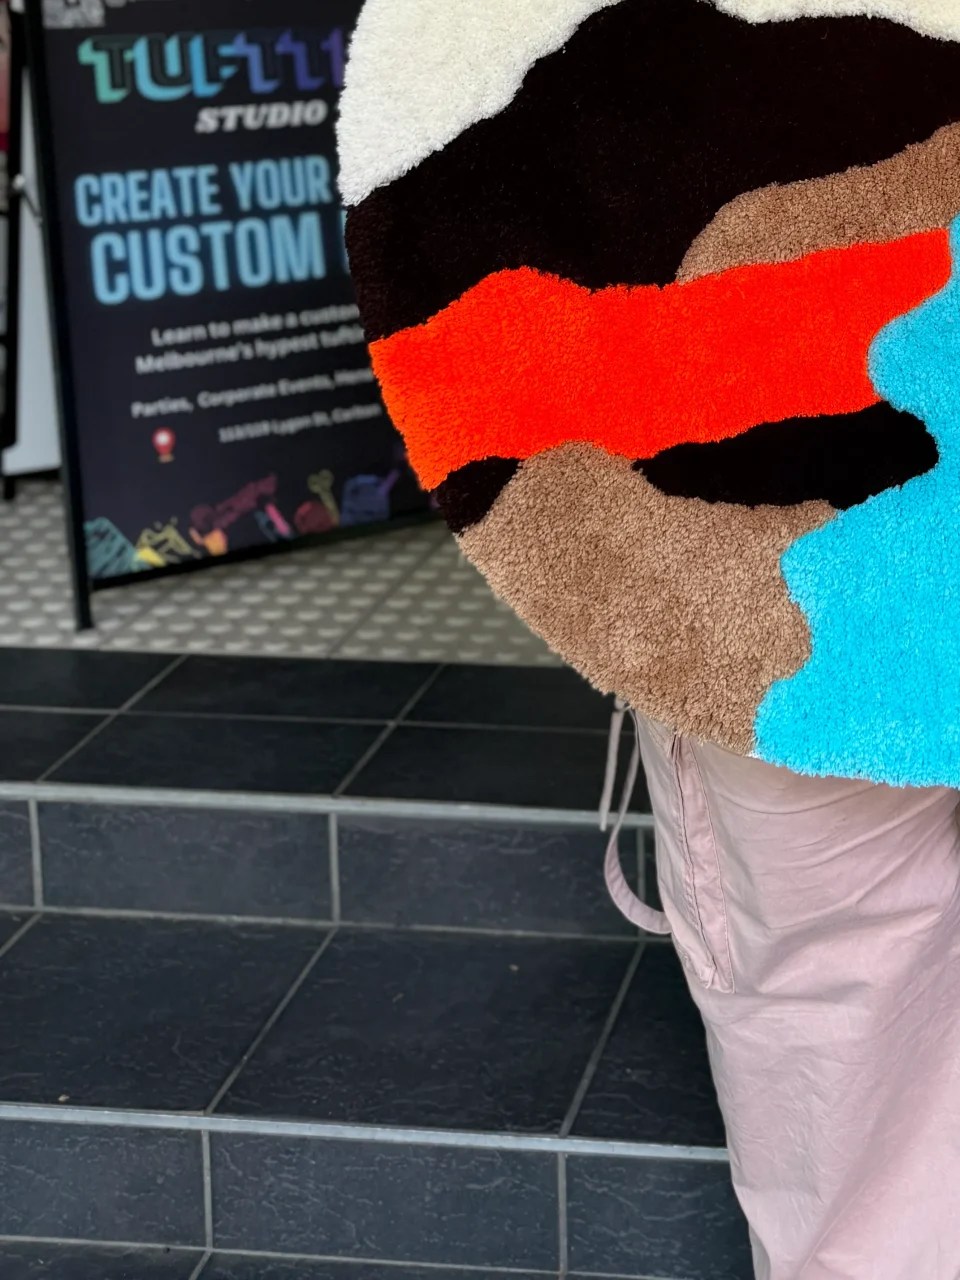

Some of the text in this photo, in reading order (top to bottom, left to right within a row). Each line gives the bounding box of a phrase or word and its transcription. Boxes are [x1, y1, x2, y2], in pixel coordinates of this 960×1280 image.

[195, 99, 328, 134] STUDIO
[74, 154, 333, 227] CREATE YOUR
[90, 211, 326, 306] CUSTOM
[151, 325, 207, 347] Learn
[208, 321, 231, 339] to
[232, 312, 282, 335] make
